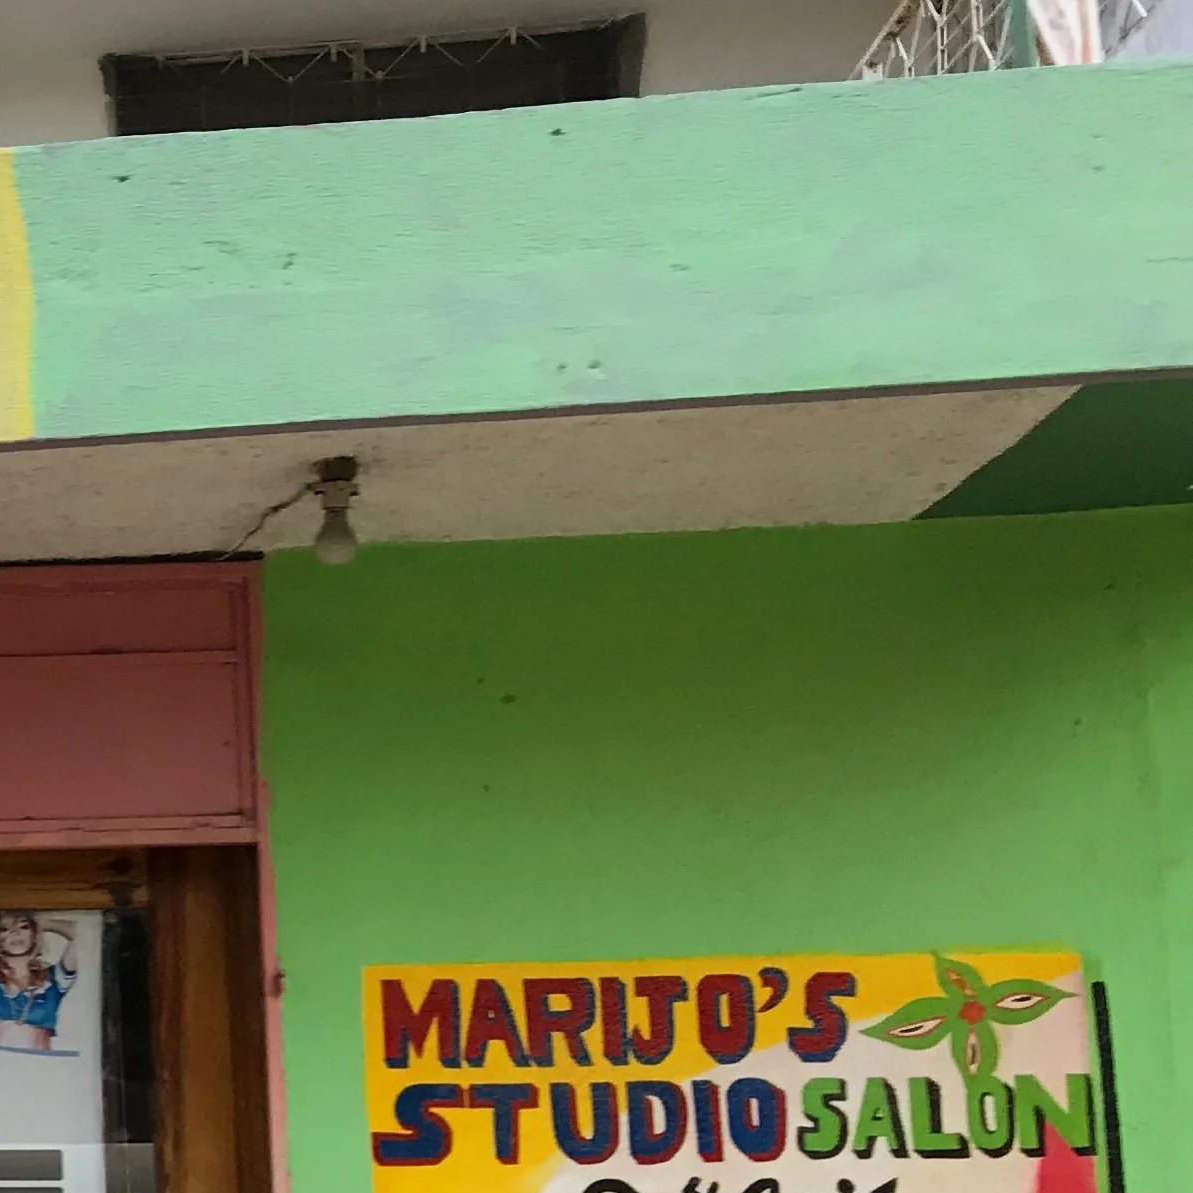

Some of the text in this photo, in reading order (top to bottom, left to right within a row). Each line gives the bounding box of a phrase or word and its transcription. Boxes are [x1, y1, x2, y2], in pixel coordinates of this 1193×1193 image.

[380, 966, 857, 1069] MARIJO'S
[372, 1073, 1099, 1167] STUDIO SALON
